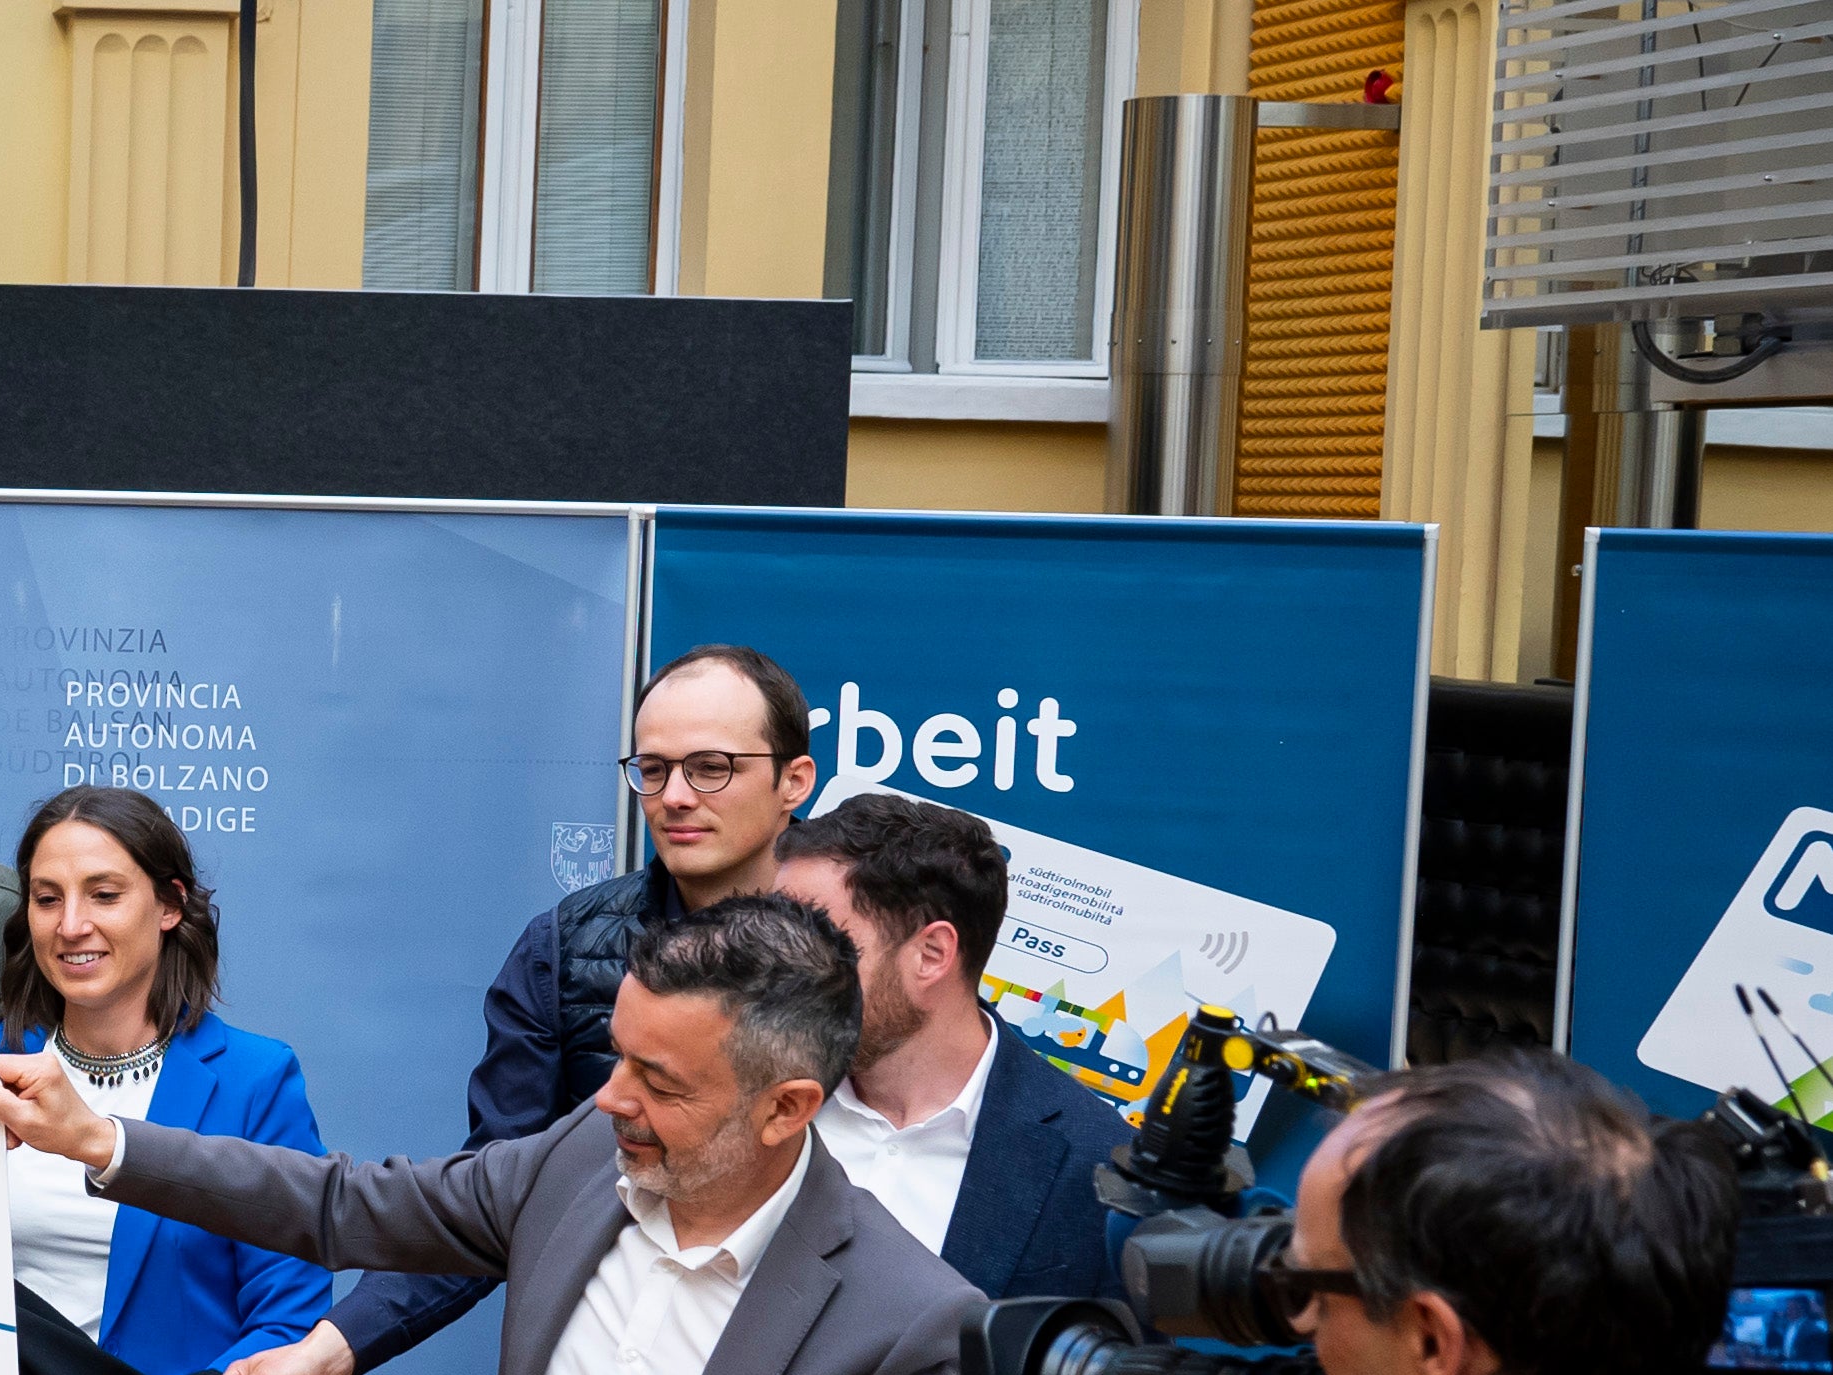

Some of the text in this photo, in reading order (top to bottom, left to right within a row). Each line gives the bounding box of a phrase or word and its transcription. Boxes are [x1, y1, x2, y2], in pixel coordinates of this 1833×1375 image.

[65, 681, 242, 710] PROVINCIA
[63, 722, 257, 751] AUTONOMA
[63, 763, 269, 792] DI BOLZANO
[1008, 873, 1124, 916] altoadigemobilità
[1027, 866, 1113, 899] südtirolmobil
[1016, 889, 1113, 926] südtirolmubiltà
[1011, 926, 1067, 958] Pass
